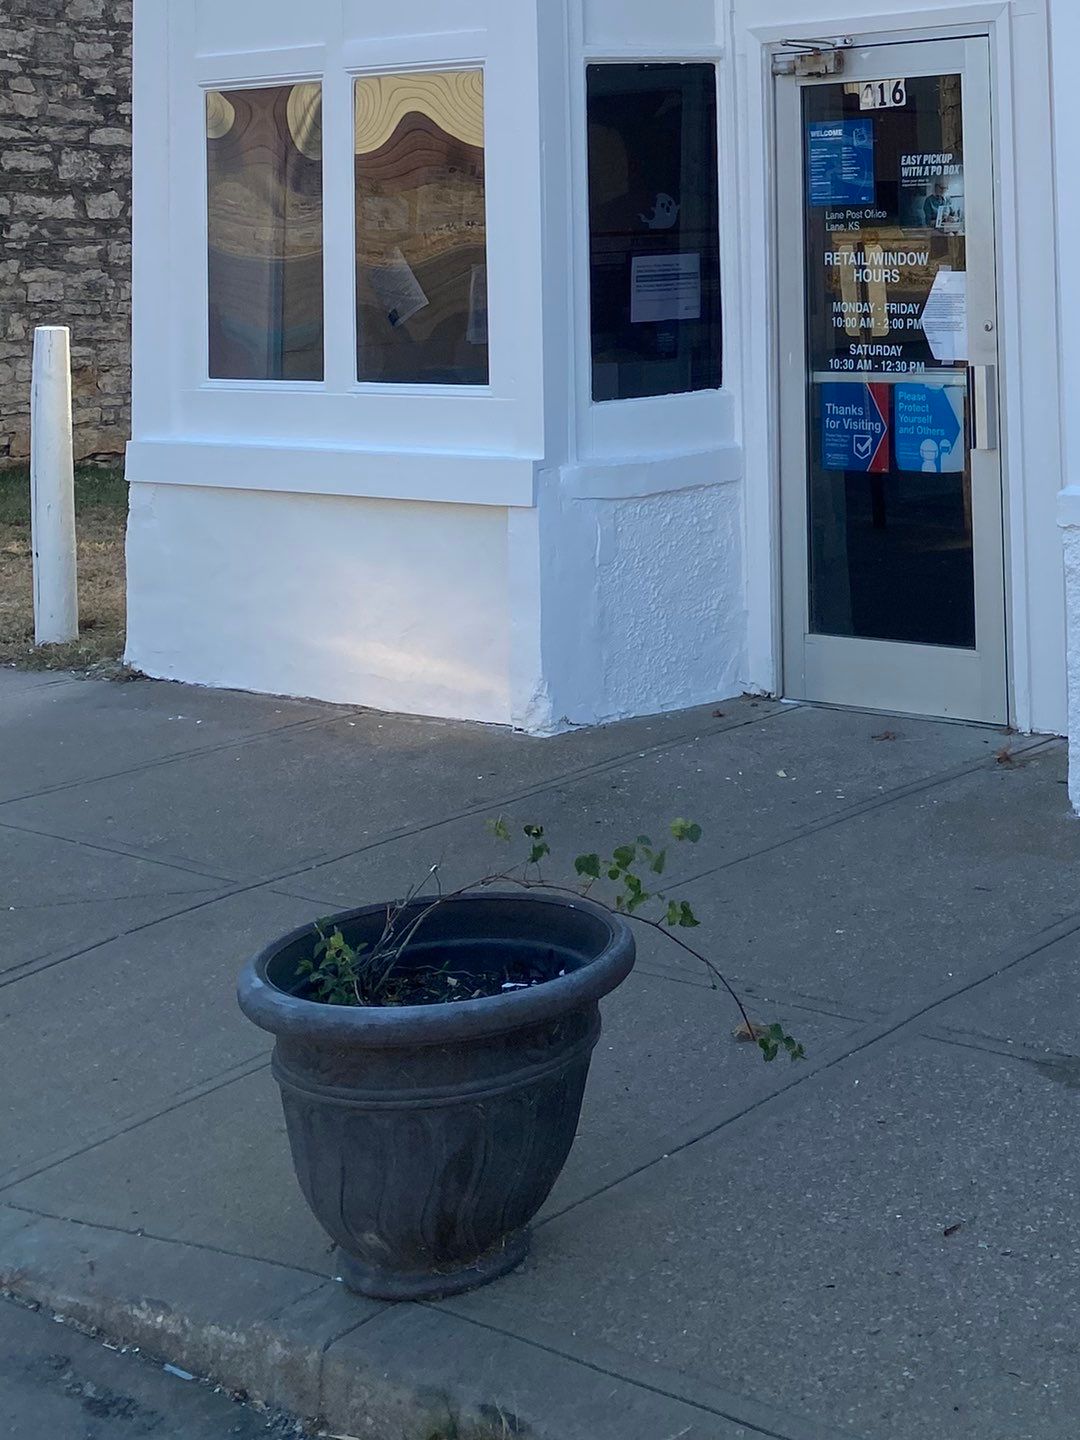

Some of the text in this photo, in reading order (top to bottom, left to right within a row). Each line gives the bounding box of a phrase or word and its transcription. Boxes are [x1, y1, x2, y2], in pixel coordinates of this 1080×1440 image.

[810, 128, 843, 138] WELCOME
[901, 153, 953, 166] EASY PICKUP
[901, 166, 923, 178] WITH
[923, 166, 930, 177] A
[930, 165, 942, 176] PO
[825, 209, 888, 220] Lane Post Office
[825, 221, 860, 232] Lane, KS
[824, 251, 930, 267] RETAIL/WINDOW
[853, 268, 900, 283] HOURS
[832, 302, 875, 314] MONDAY
[884, 302, 921, 315] FRIDAY
[831, 316, 858, 328] 10:00
[859, 317, 875, 329] AM
[883, 317, 904, 329] 2:00
[906, 318, 922, 330] PM
[849, 343, 903, 357] SATURDAY
[828, 359, 855, 370] 10:30
[856, 359, 872, 371] AM
[880, 360, 907, 372] 12:30
[909, 361, 925, 373] PM
[898, 391, 927, 402] Please
[825, 403, 864, 416] Thanks
[898, 402, 930, 413] Protect
[825, 417, 882, 434] for Visiting
[898, 413, 933, 425] Yourself
[898, 425, 945, 437] and Others
